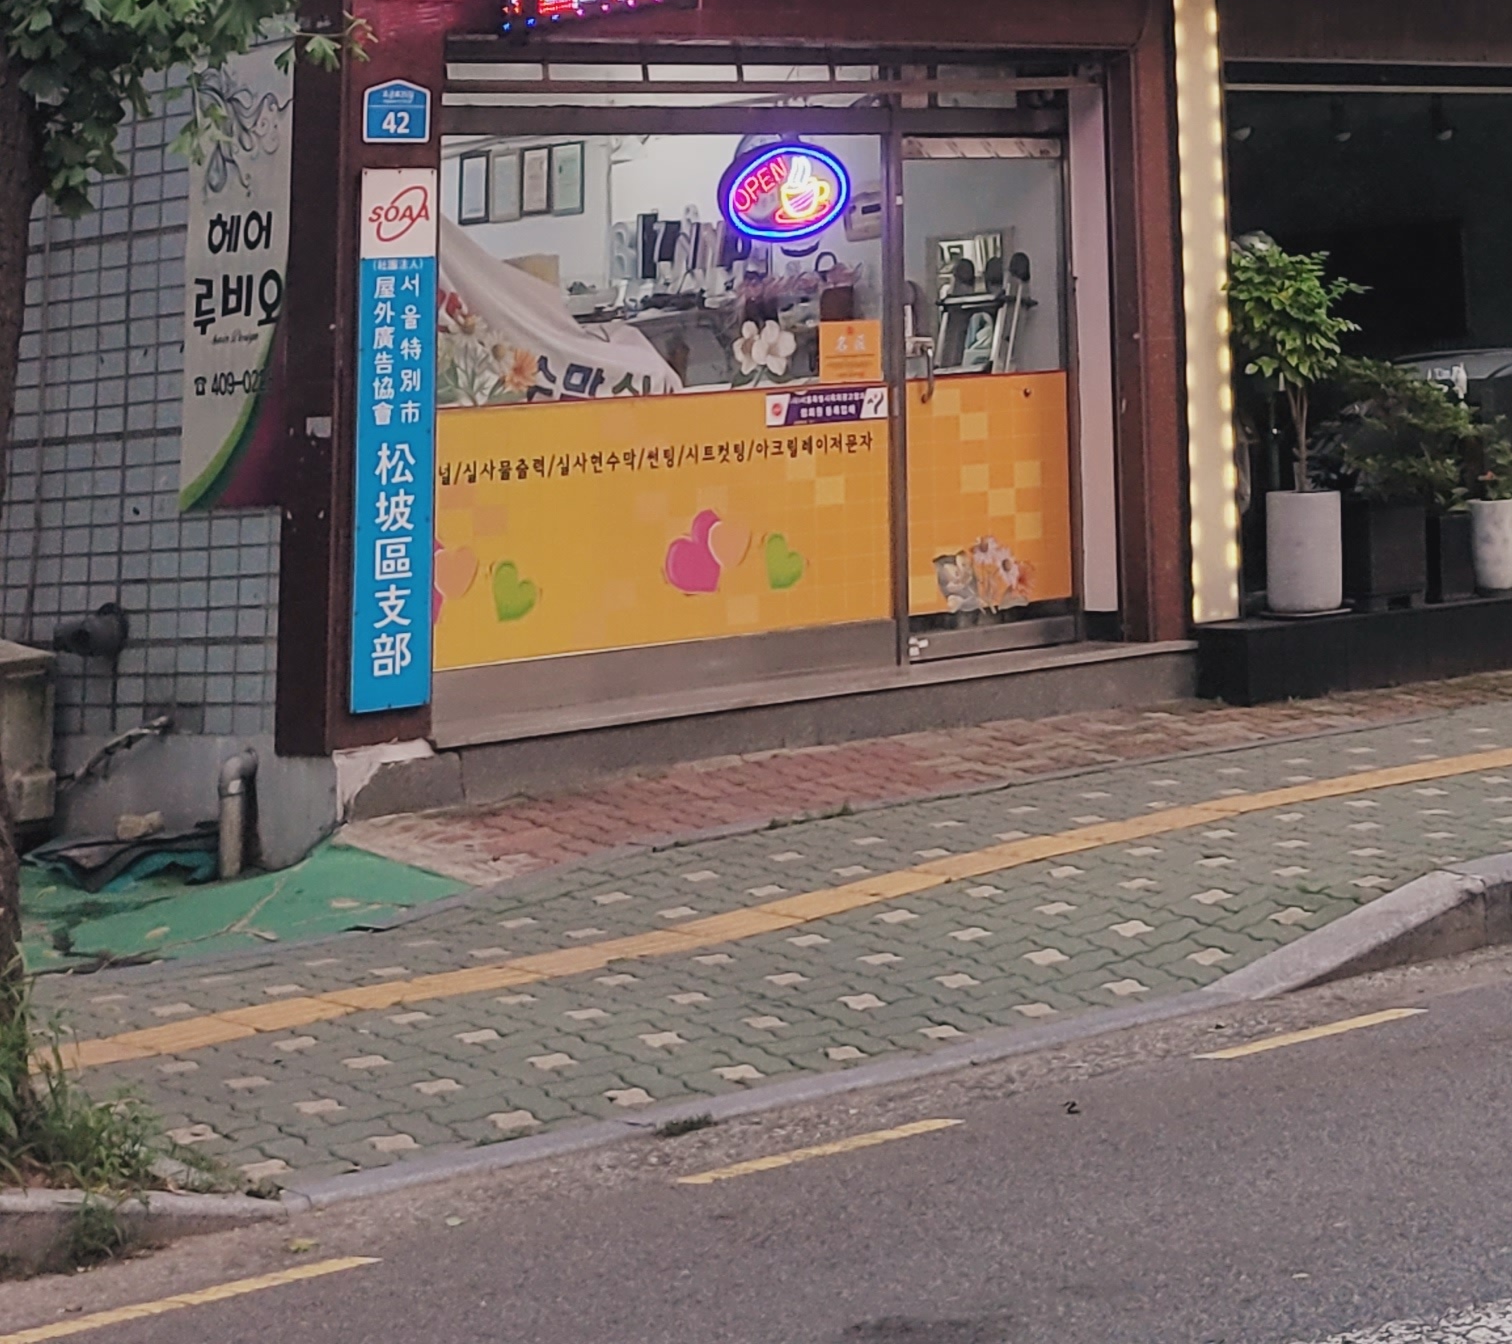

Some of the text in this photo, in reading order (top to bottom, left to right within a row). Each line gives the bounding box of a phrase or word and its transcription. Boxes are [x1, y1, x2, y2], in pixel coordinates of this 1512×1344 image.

[382, 111, 410, 134] 42
[733, 156, 789, 211] OPEN
[207, 210, 273, 254] 헤어
[368, 204, 430, 223] SOAA
[192, 268, 284, 336] 루비오
[371, 442, 416, 678] 松坡區支部
